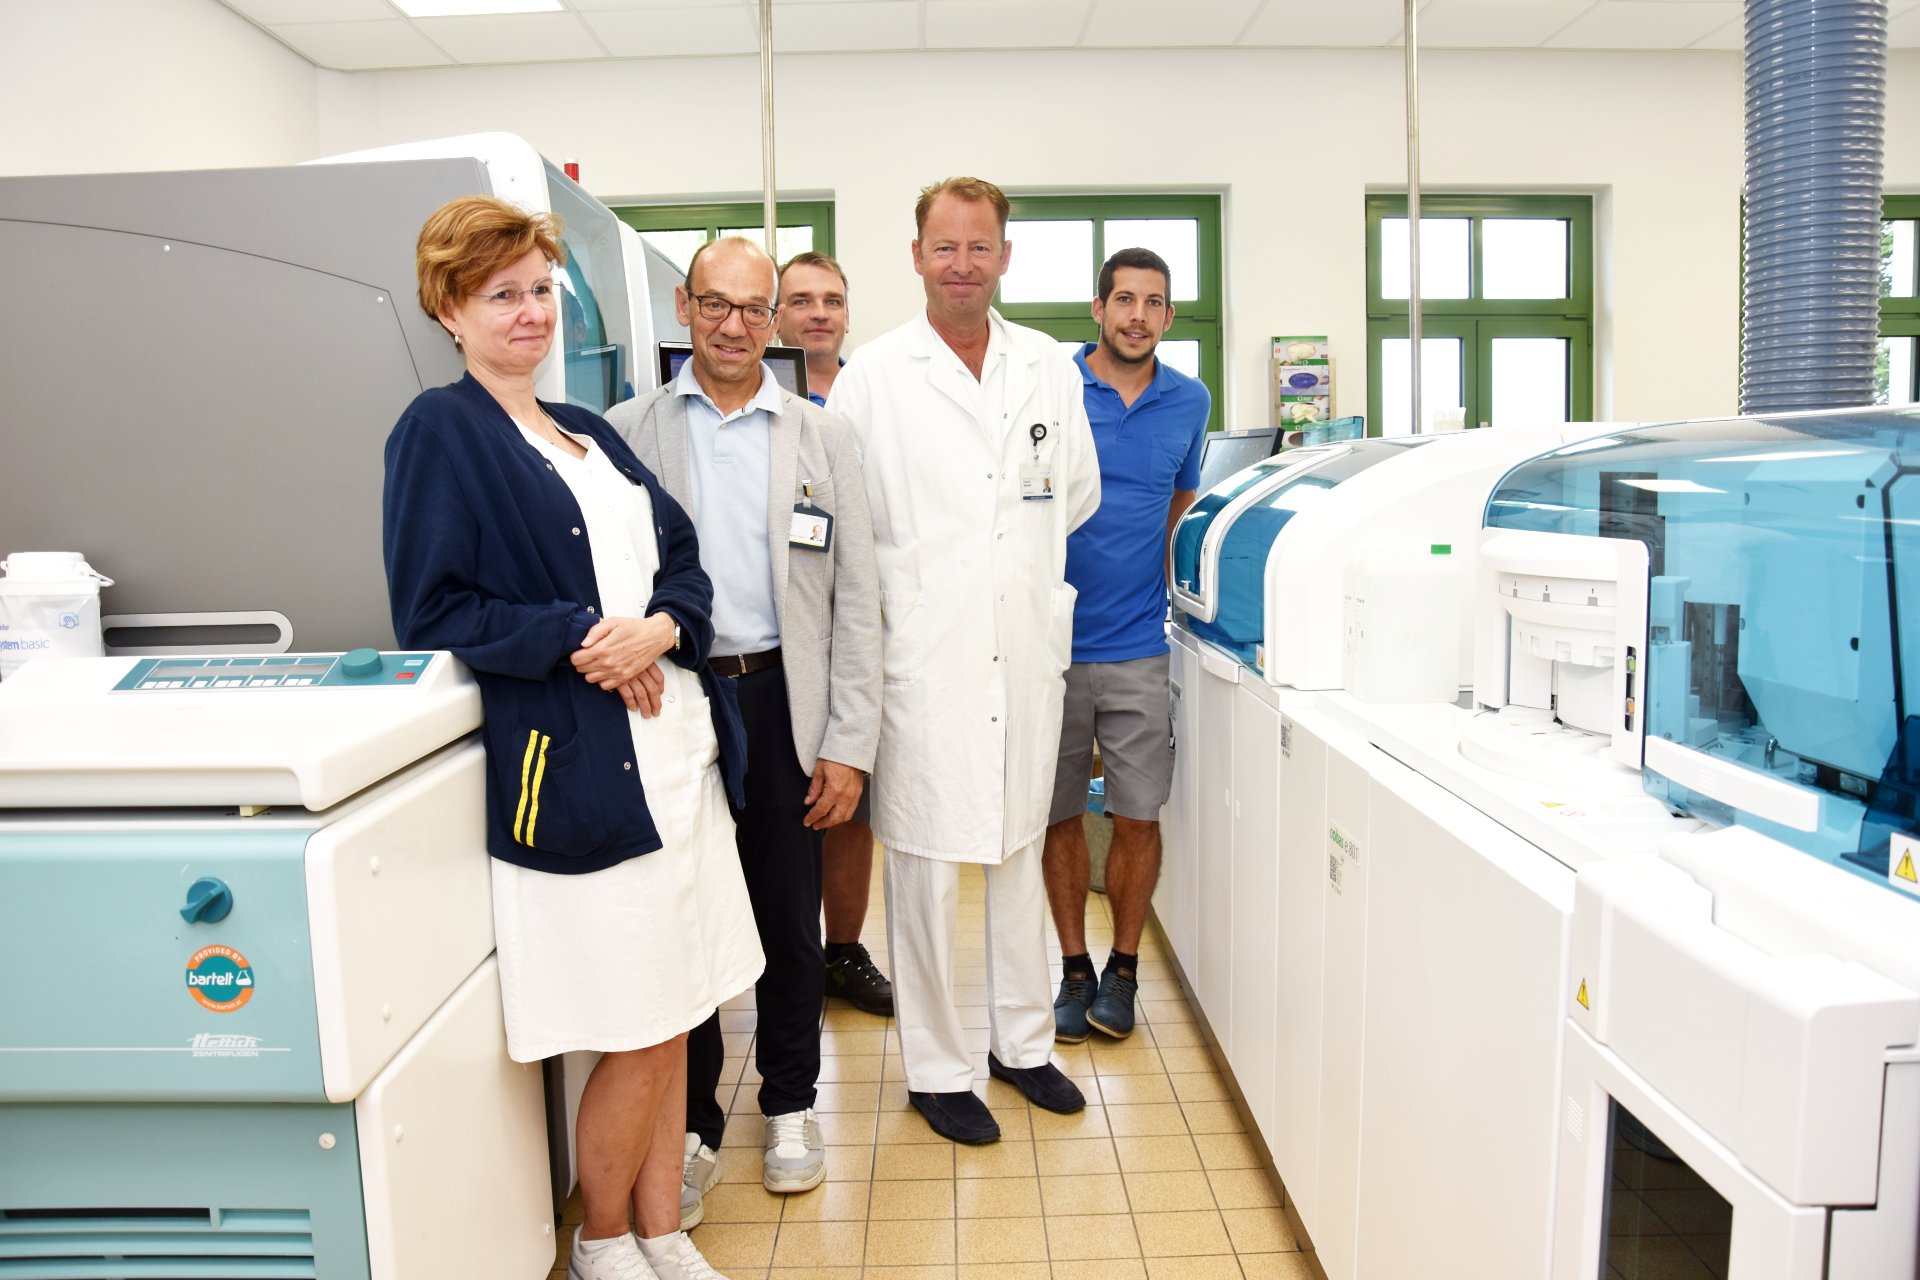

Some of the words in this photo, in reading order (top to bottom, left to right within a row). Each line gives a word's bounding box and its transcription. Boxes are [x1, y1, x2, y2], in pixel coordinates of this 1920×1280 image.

[20, 638, 50, 650] basic
[194, 947, 231, 962] PROVIDED
[231, 952, 243, 962] BY
[189, 971, 234, 985] bartelt
